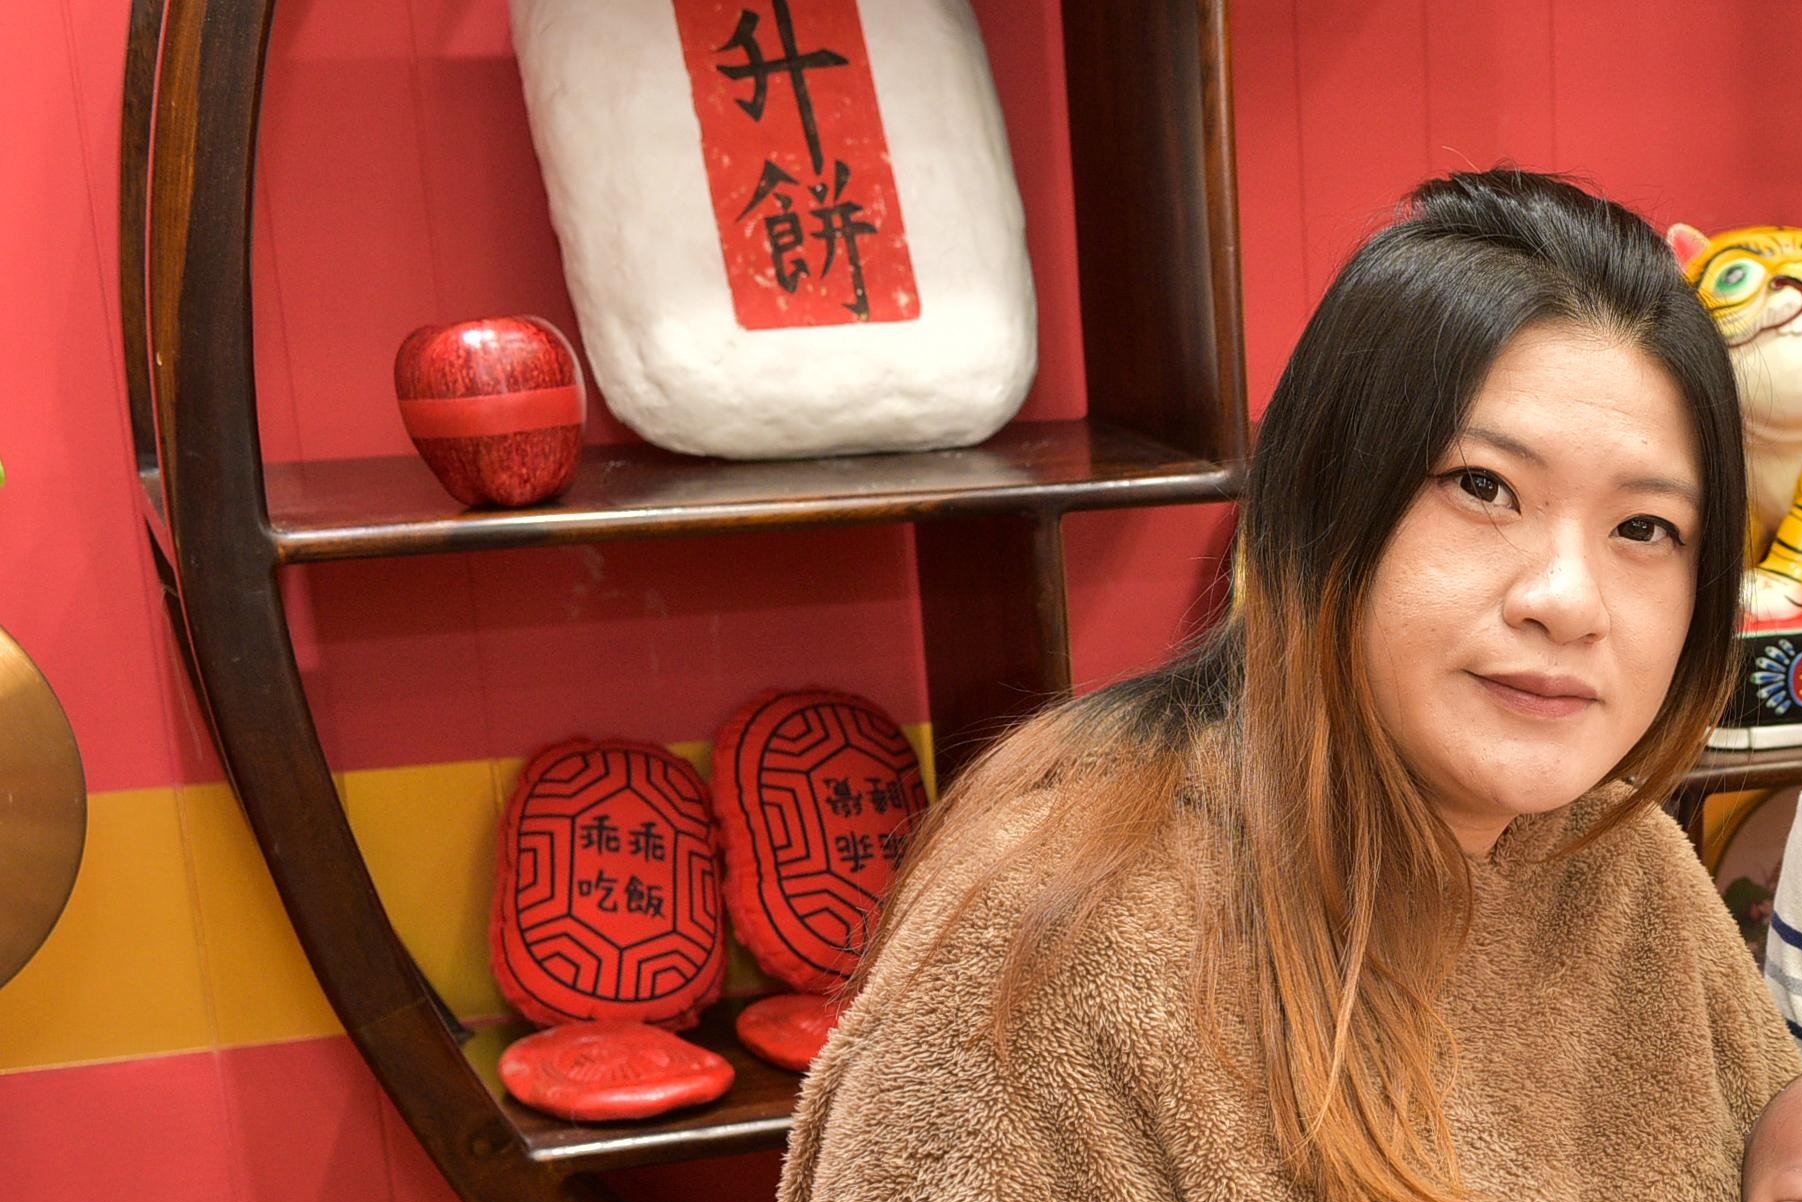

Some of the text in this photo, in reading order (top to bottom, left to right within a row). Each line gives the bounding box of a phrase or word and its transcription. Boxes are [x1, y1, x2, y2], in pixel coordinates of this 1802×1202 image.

[715, 0, 877, 322] 升餅
[580, 814, 666, 862] 乖乖
[578, 869, 666, 919] 吃飯
